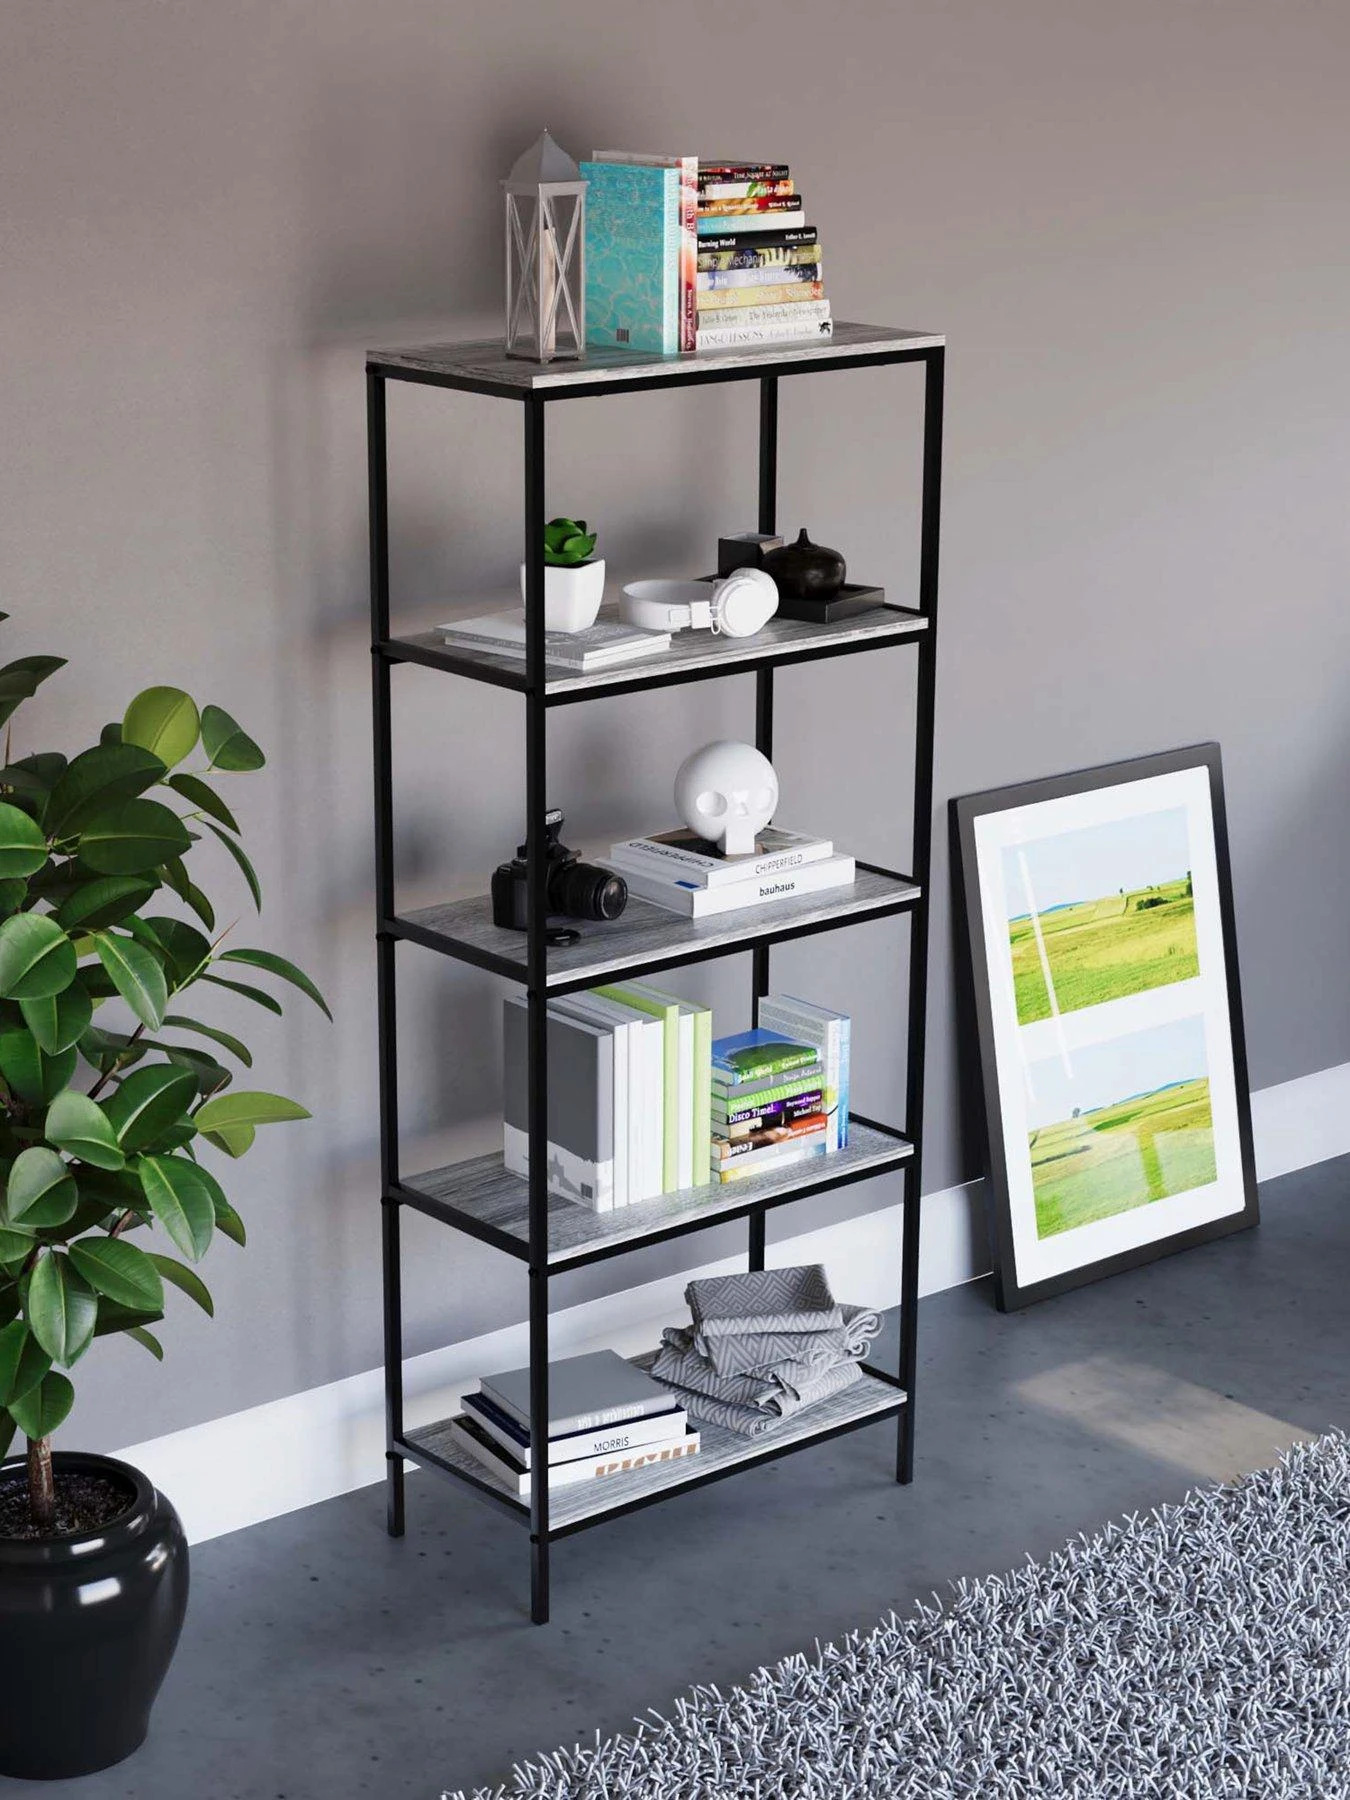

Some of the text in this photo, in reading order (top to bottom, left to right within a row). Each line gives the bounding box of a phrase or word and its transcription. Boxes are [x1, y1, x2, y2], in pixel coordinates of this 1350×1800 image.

[720, 238, 736, 246] World
[628, 842, 714, 867] CHIPPERFIELD
[755, 854, 803, 874] CHIPPERFIELD
[759, 881, 795, 897] bauhaus
[728, 1111, 750, 1124] Disco
[594, 1436, 629, 1452] MORRIS
